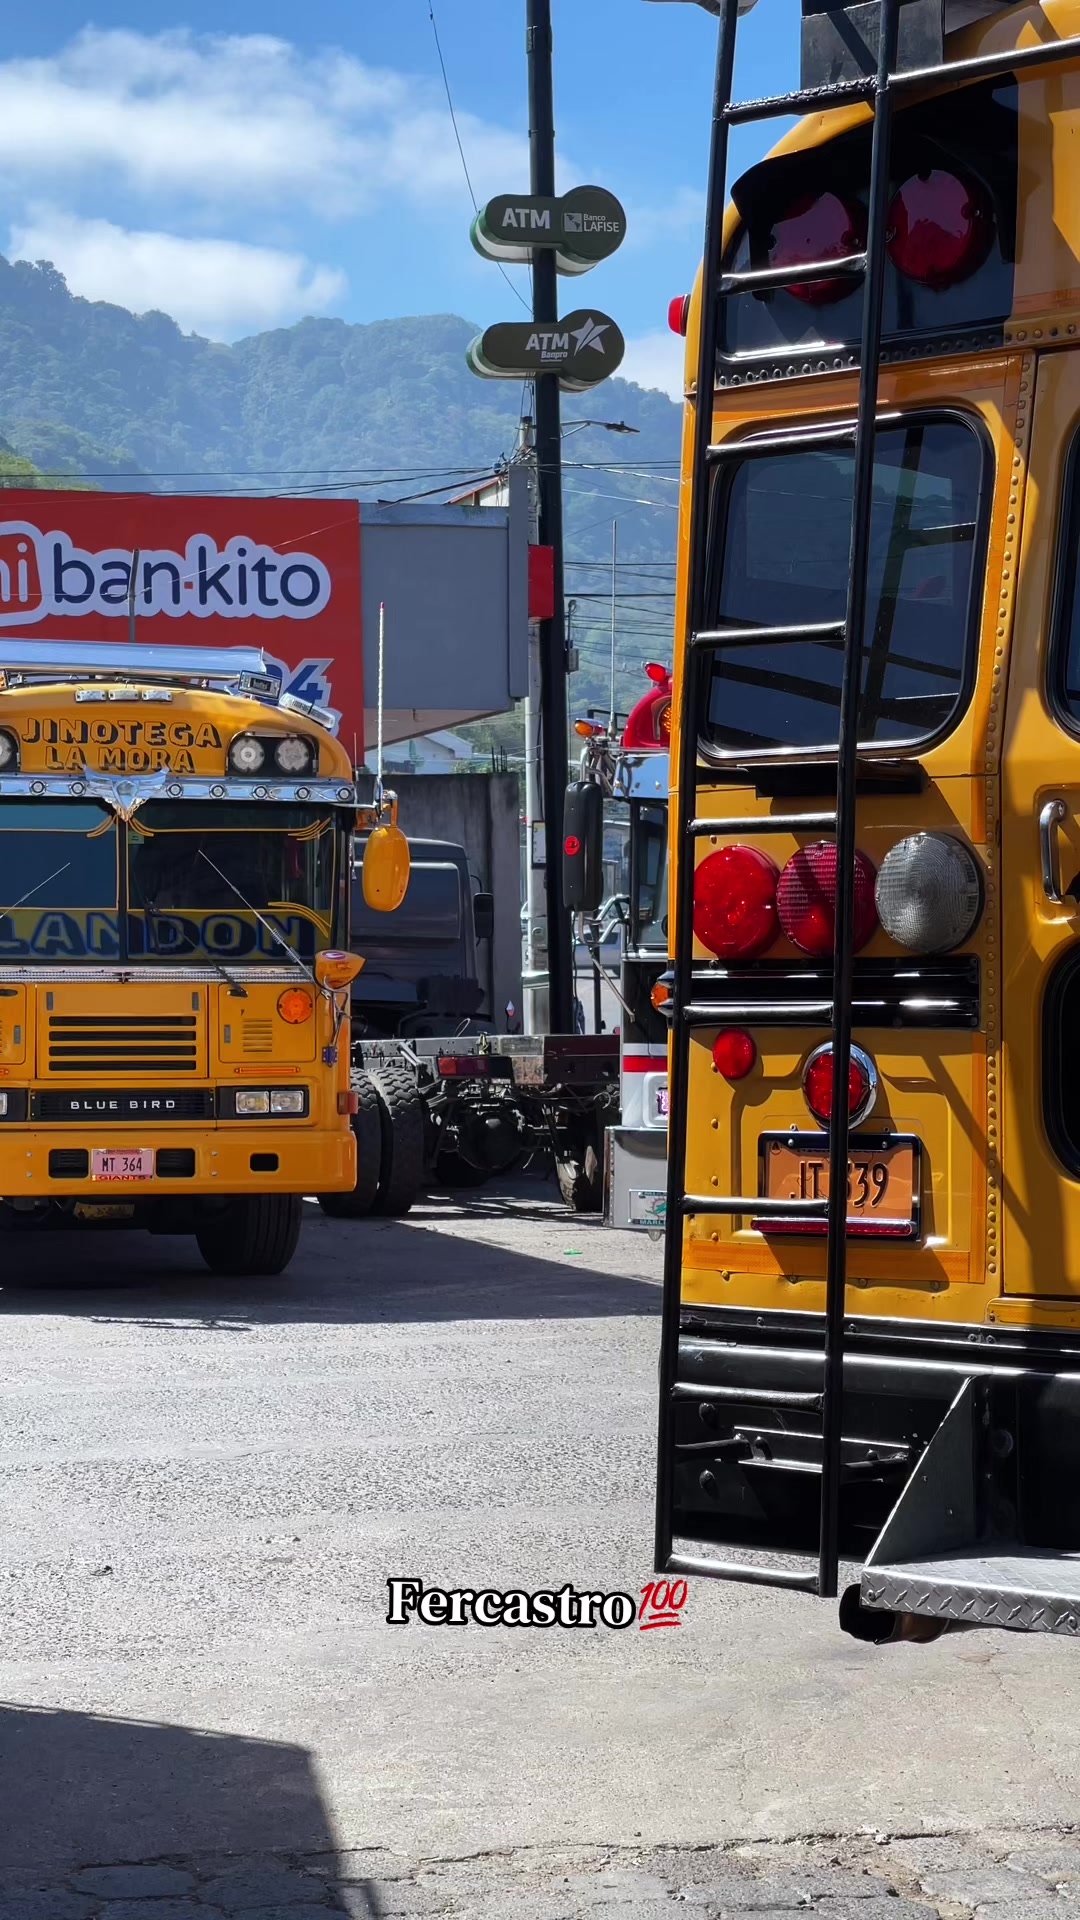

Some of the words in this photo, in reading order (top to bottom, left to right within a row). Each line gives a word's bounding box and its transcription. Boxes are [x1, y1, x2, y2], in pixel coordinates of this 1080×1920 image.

[502, 208, 550, 229] ATM
[583, 213, 606, 222] Banco
[583, 221, 620, 233] LAFISE
[525, 333, 569, 351] ATM
[541, 350, 568, 361] Banpro
[22, 717, 222, 749] JINOTEGA
[45, 746, 87, 771] LA
[98, 747, 196, 774] MORA
[70, 1100, 119, 1110] BLUE
[129, 1099, 176, 1109] BIRD
[101, 1157, 116, 1172] MT
[122, 1157, 143, 1172] 364
[847, 1161, 888, 1208] 39
